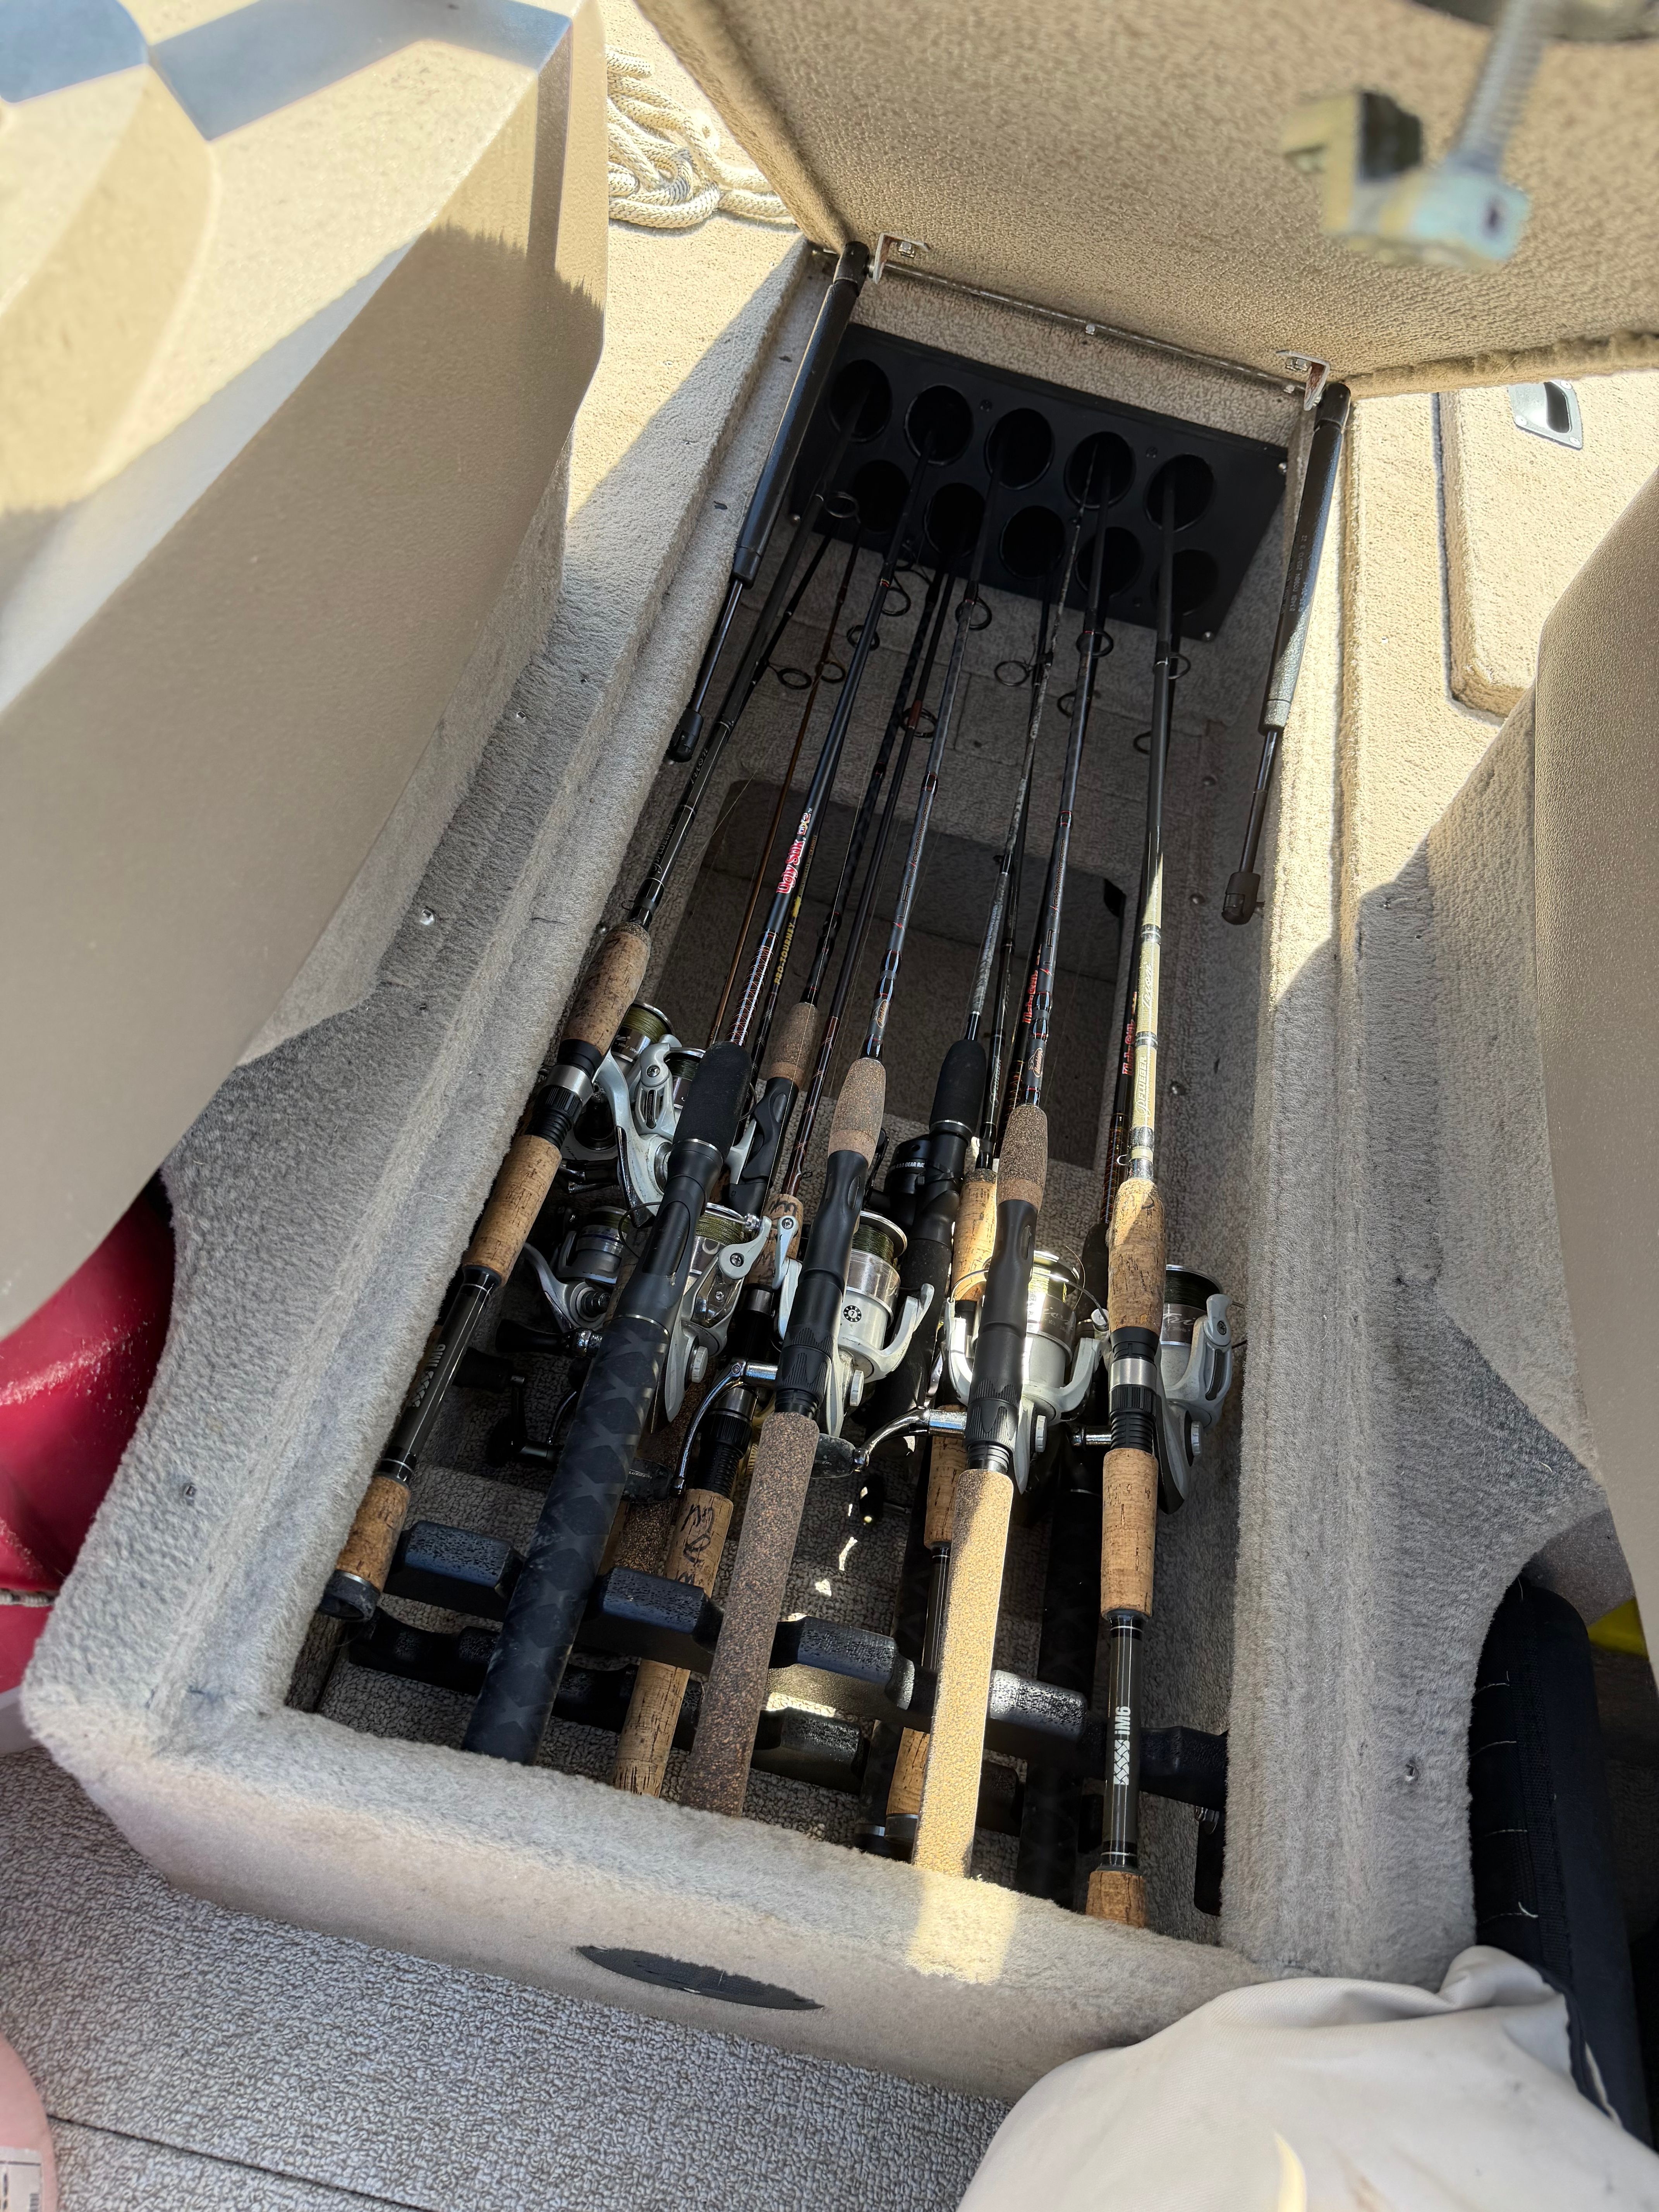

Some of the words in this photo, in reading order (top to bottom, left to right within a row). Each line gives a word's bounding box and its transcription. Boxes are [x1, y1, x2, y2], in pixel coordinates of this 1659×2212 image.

[785, 839, 806, 866] Stik
[776, 864, 798, 894] Ugly
[774, 922, 795, 985] PRO-TOURNEY
[1142, 963, 1152, 1008] Trion
[878, 1000, 888, 1025] Berkley
[1034, 1049, 1043, 1074] Berkley
[1135, 1055, 1151, 1116] PFLUEGER
